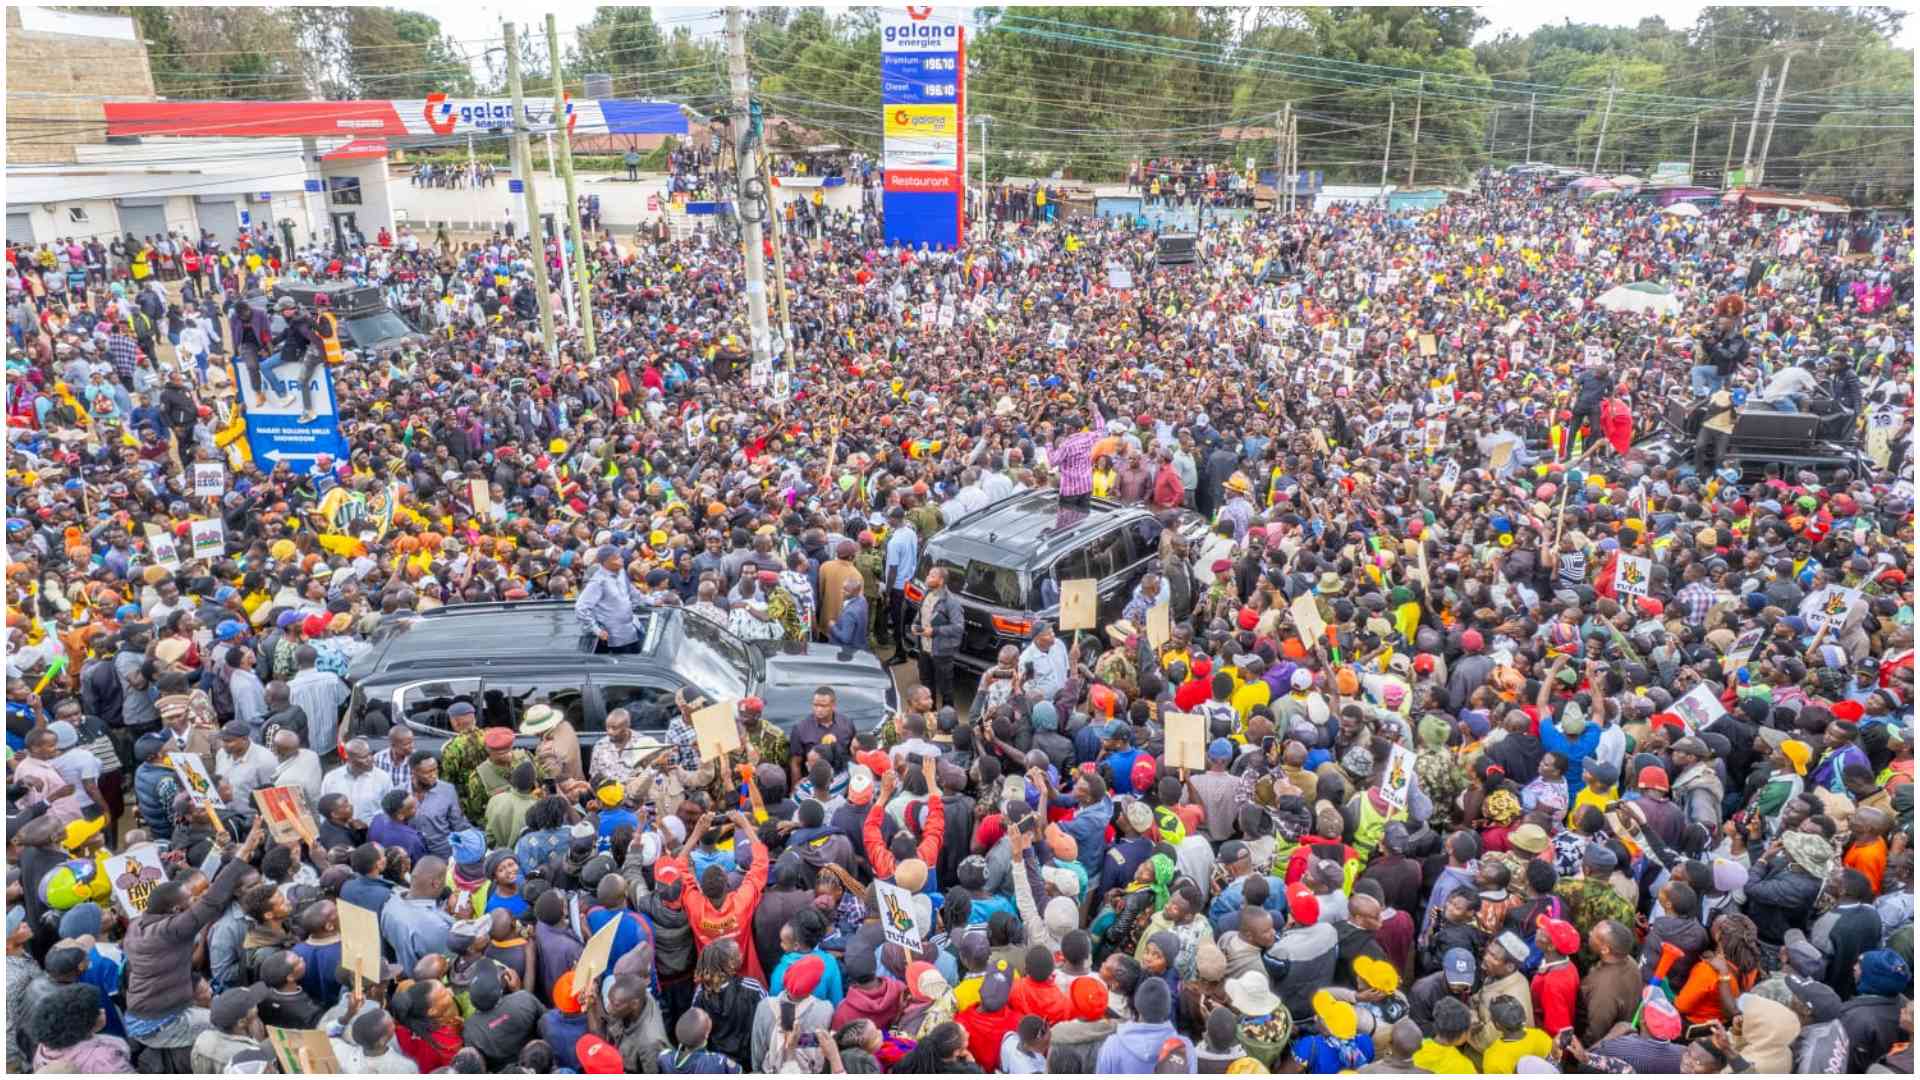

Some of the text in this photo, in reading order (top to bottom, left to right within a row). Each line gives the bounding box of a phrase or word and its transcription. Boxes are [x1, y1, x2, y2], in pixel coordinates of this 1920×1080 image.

[885, 22, 956, 42] galana
[898, 38, 942, 49] energies
[891, 175, 950, 187] Restaurant
[272, 434, 316, 443] SHOWROOM
[885, 928, 922, 950] TUTAM
